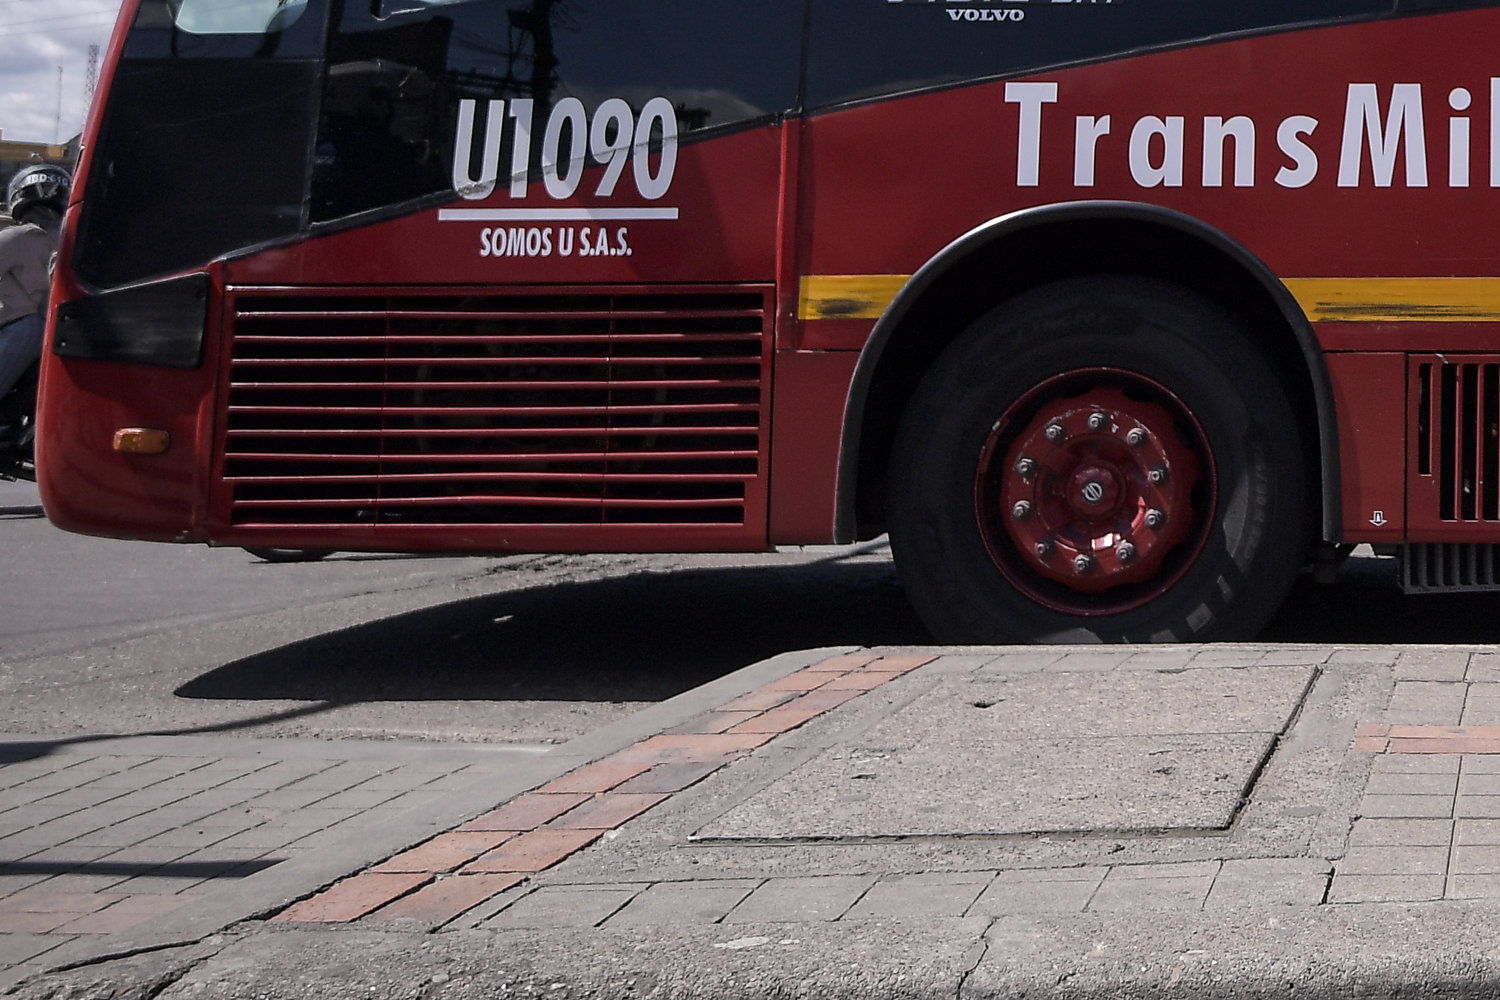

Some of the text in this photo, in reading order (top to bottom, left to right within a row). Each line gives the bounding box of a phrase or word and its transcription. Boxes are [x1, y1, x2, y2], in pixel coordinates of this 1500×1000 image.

[946, 8, 1025, 21] VOLVO
[452, 96, 679, 200] U1090
[480, 227, 633, 257] SOMOS U S.A.S.
